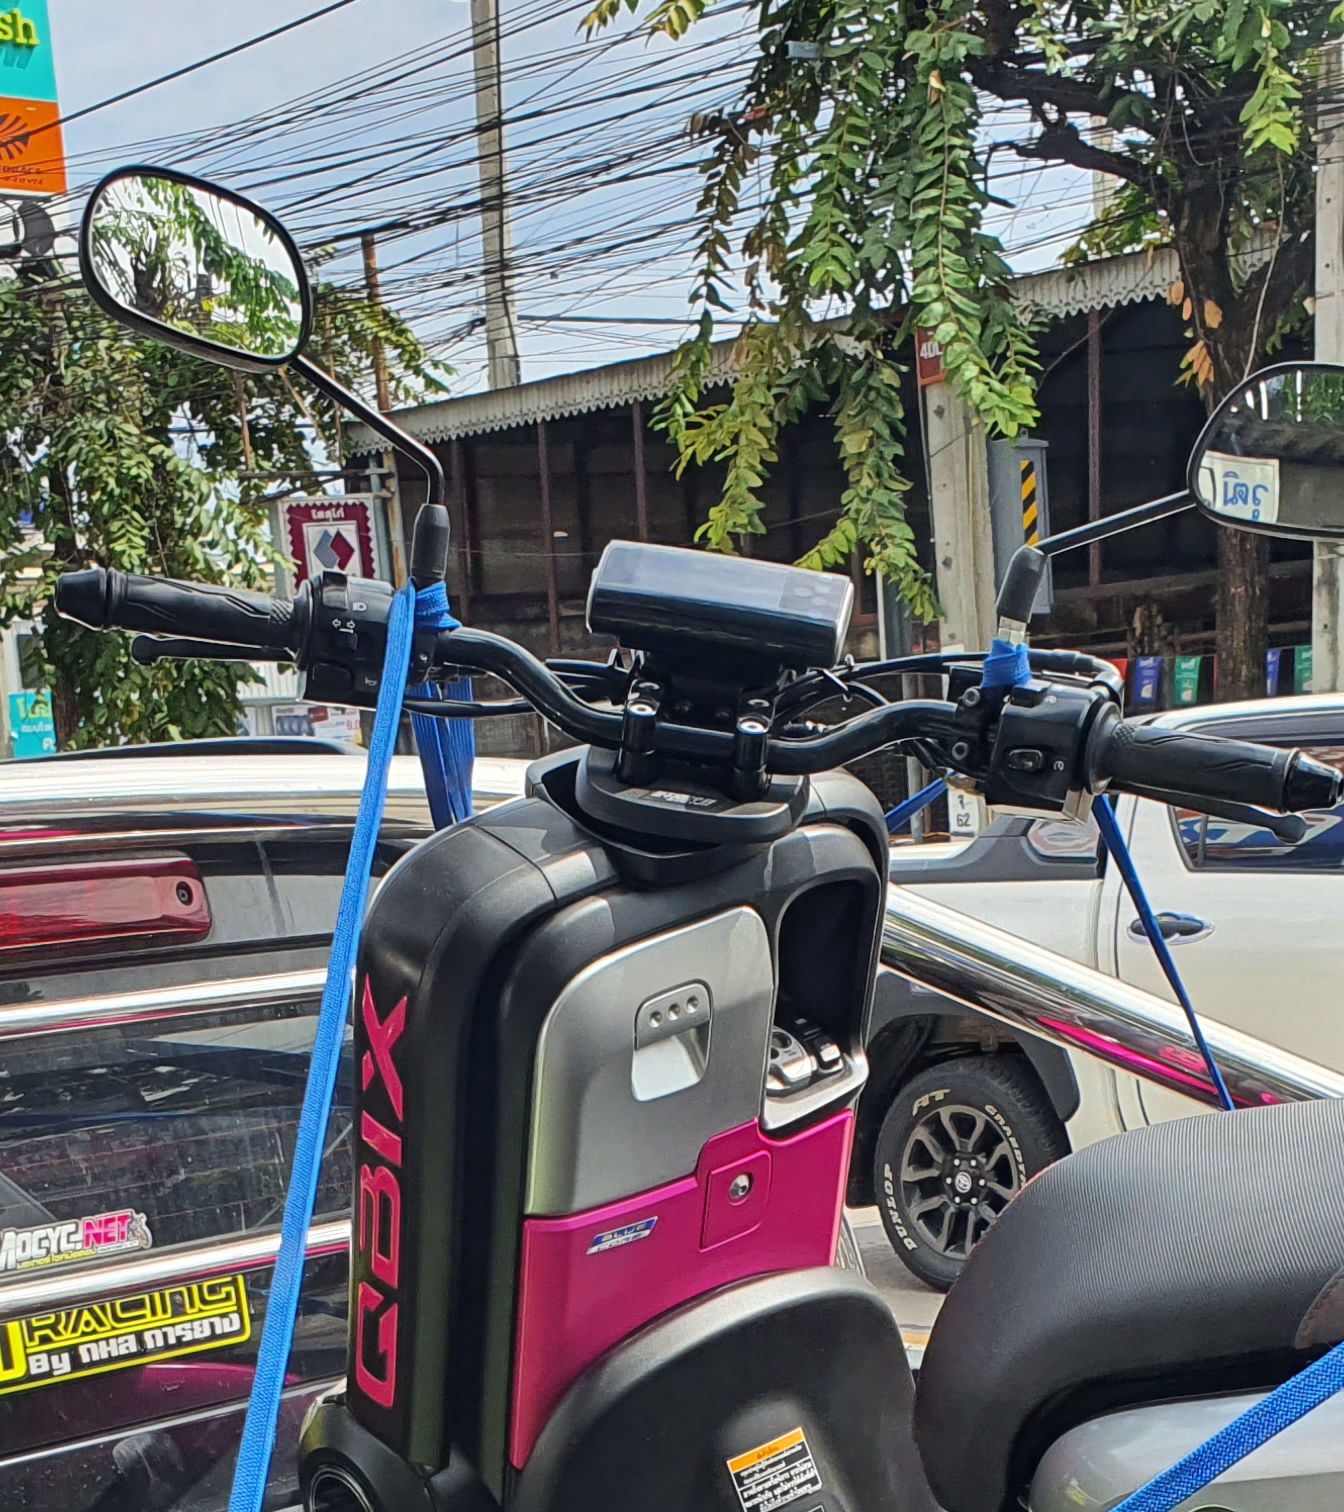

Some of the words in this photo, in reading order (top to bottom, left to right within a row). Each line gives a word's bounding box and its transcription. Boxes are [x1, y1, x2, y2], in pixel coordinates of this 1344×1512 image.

[357, 974, 409, 1408] QBIX
[883, 1163, 919, 1251] DUNLOP
[25, 1276, 239, 1348] RACING
[28, 1352, 72, 1376] By
